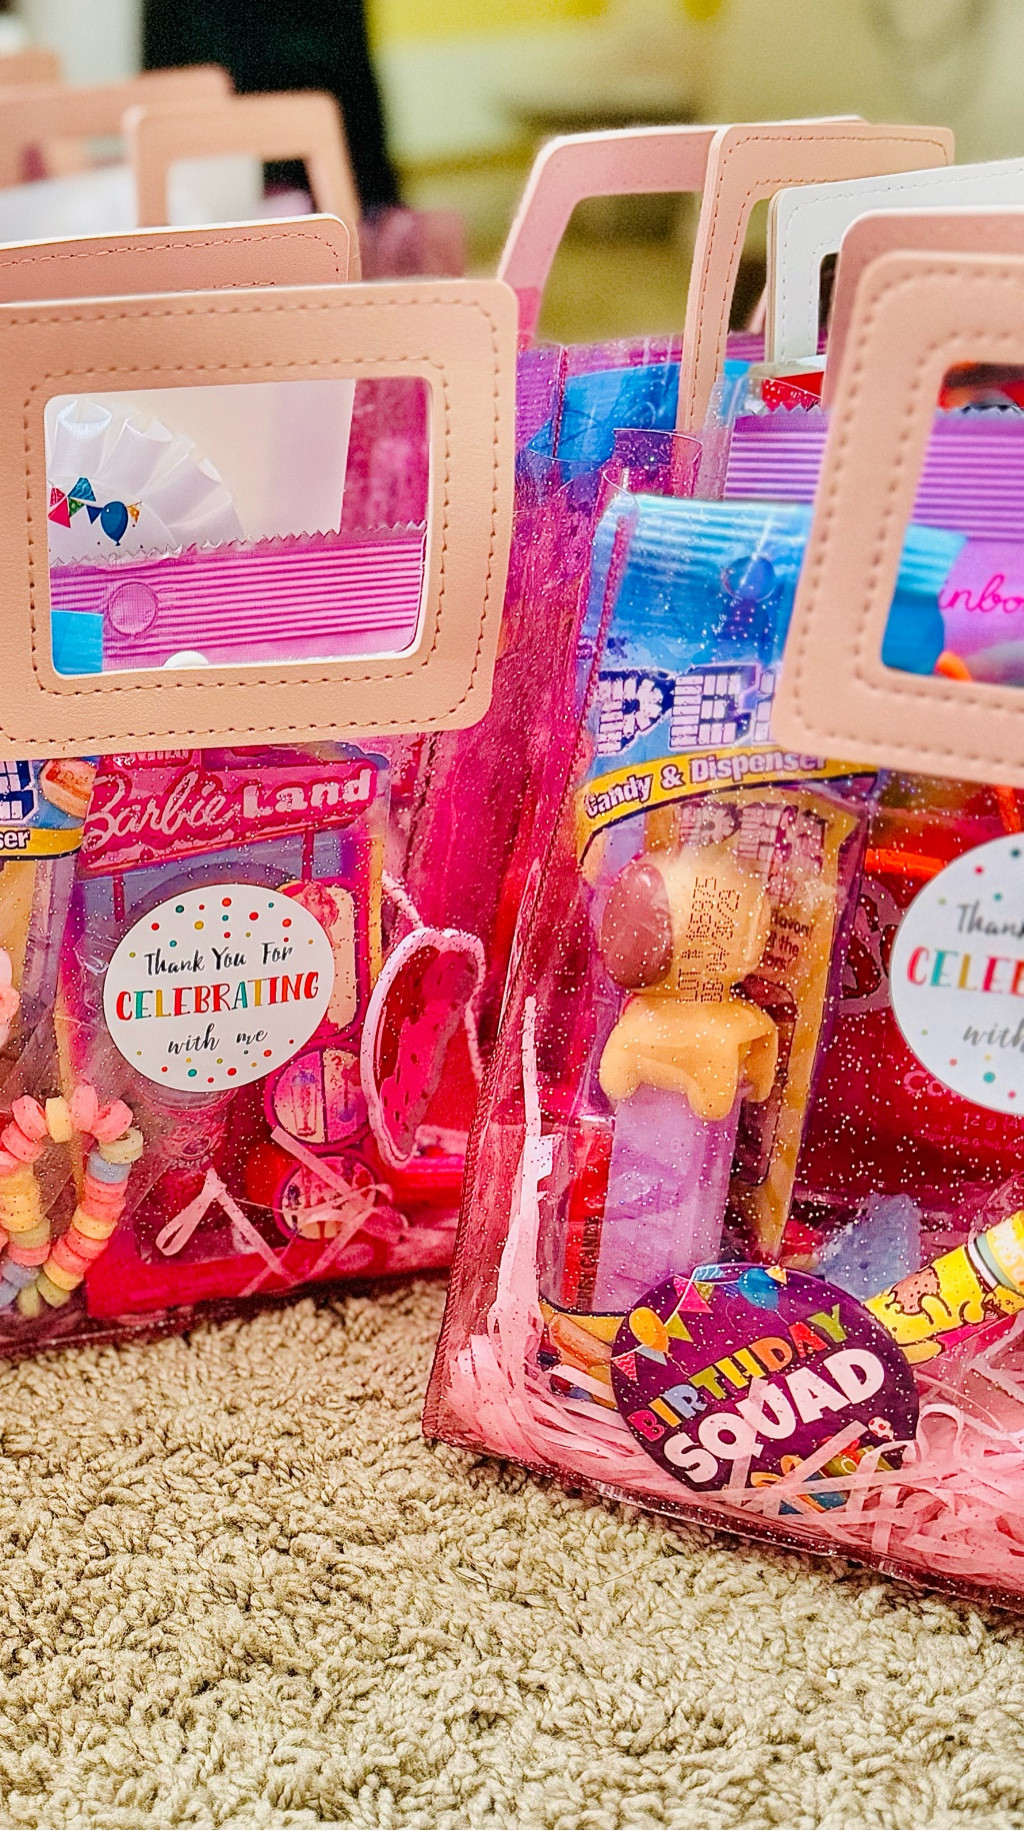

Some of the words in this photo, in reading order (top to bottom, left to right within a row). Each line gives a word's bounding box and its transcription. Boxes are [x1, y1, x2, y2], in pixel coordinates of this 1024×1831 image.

[83, 769, 240, 849] Barbie
[243, 768, 373, 819] Land
[584, 774, 653, 819] Candy
[660, 766, 685, 789] &
[690, 752, 827, 783] Dispenser
[144, 948, 205, 976] Thank
[211, 946, 247, 970] You
[261, 942, 293, 965] For
[676, 968, 702, 1003] LOT
[116, 971, 319, 1021] CELEBRATING
[168, 1023, 220, 1055] with
[236, 1029, 268, 1045] me
[627, 1303, 847, 1442] BIRTHDAY
[664, 1348, 885, 1484] SQUAD
